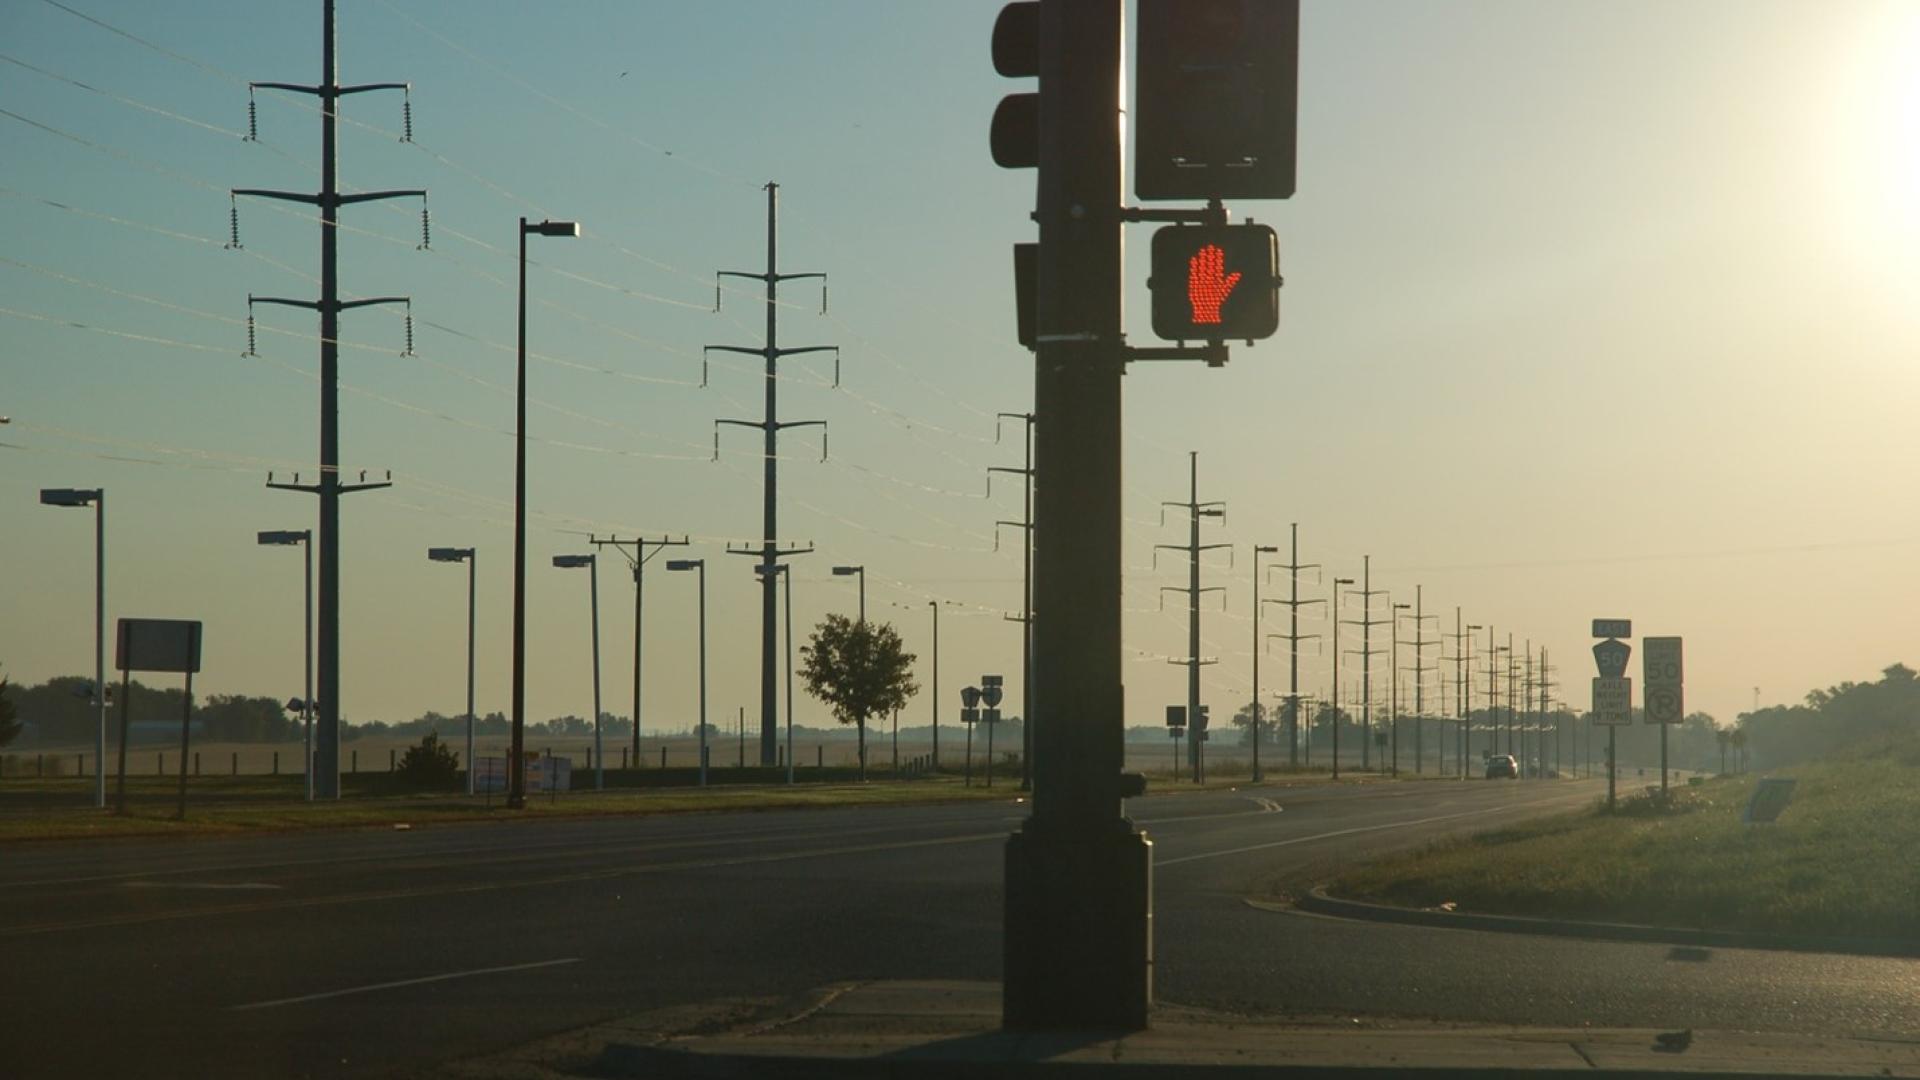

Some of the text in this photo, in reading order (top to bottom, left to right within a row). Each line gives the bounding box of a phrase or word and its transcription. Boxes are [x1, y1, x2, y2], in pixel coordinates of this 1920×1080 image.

[1601, 652, 1623, 666] 50
[1648, 663, 1679, 680] 50
[1601, 701, 1623, 709] LIMIT
[1656, 694, 1674, 713] R
